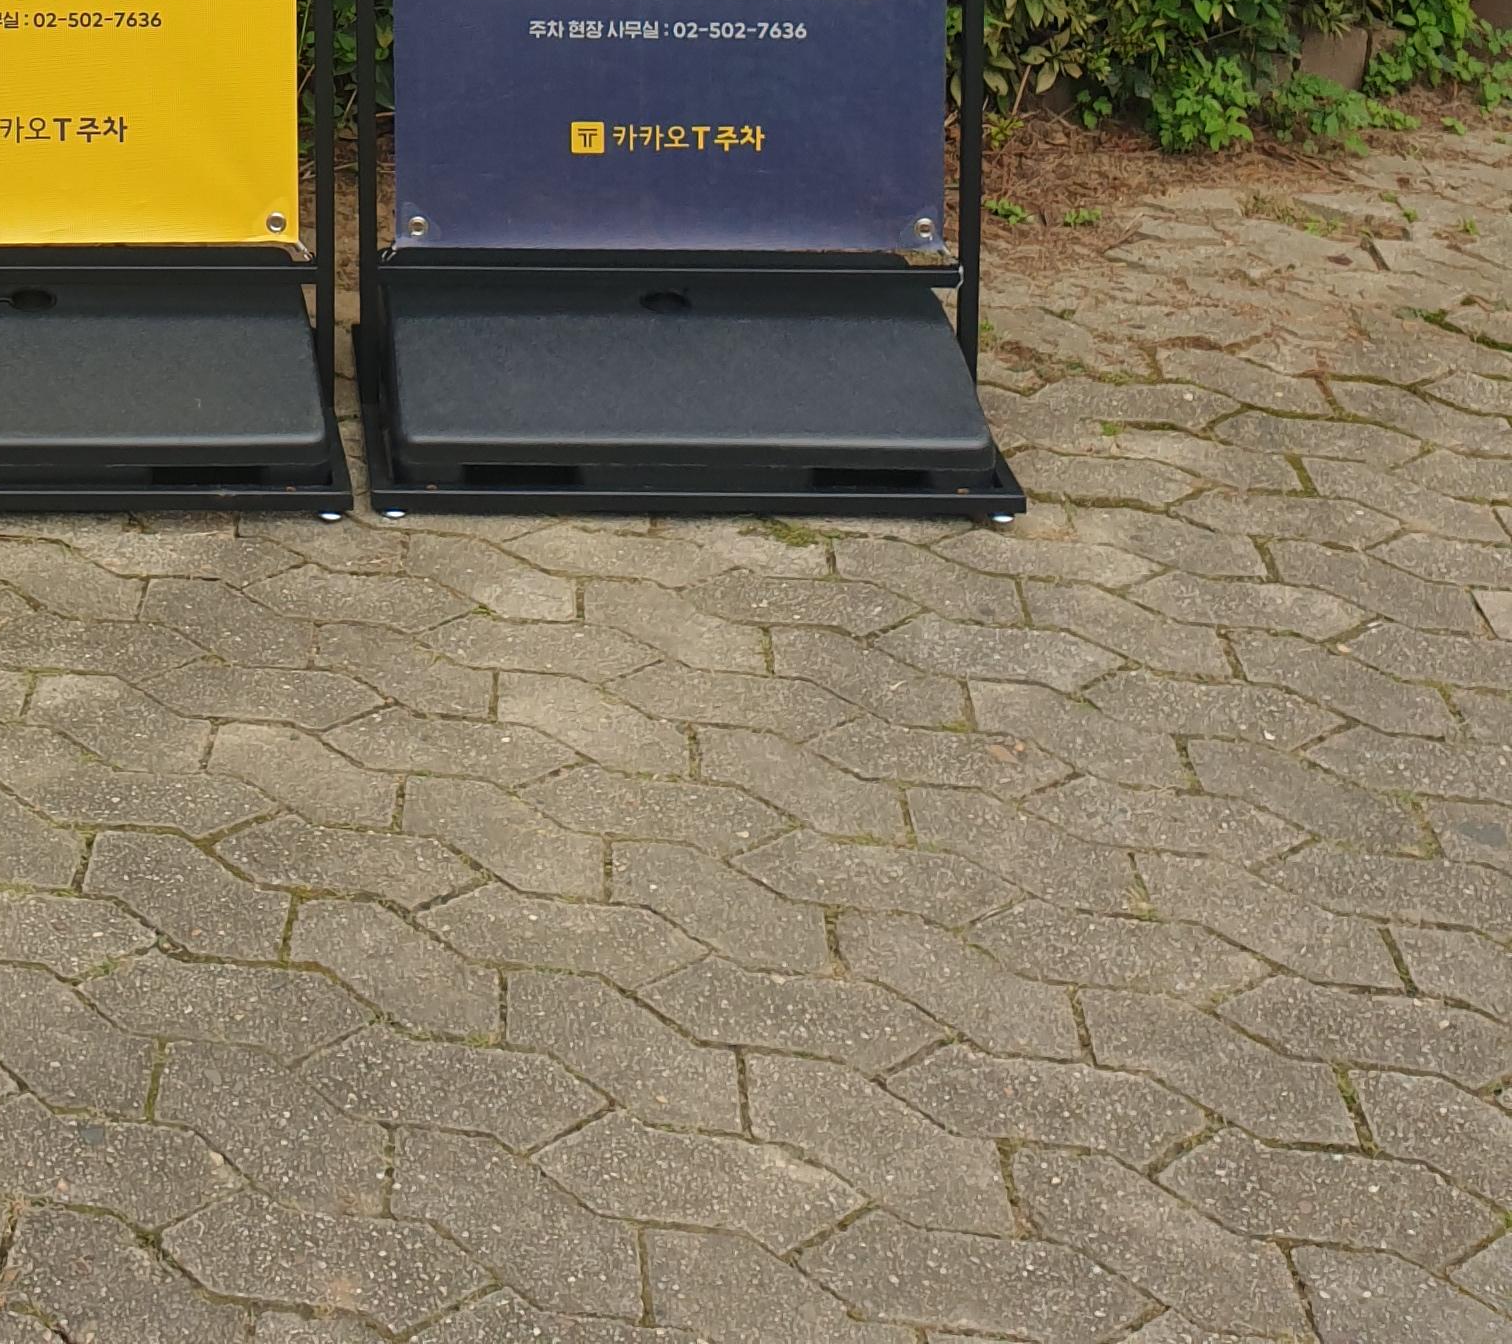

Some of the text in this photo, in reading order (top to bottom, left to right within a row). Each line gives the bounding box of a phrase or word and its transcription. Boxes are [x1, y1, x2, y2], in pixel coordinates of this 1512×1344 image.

[33, 12, 162, 29] 02-502-7636
[529, 21, 807, 40] 주차 현장 사무실 02-502-7636
